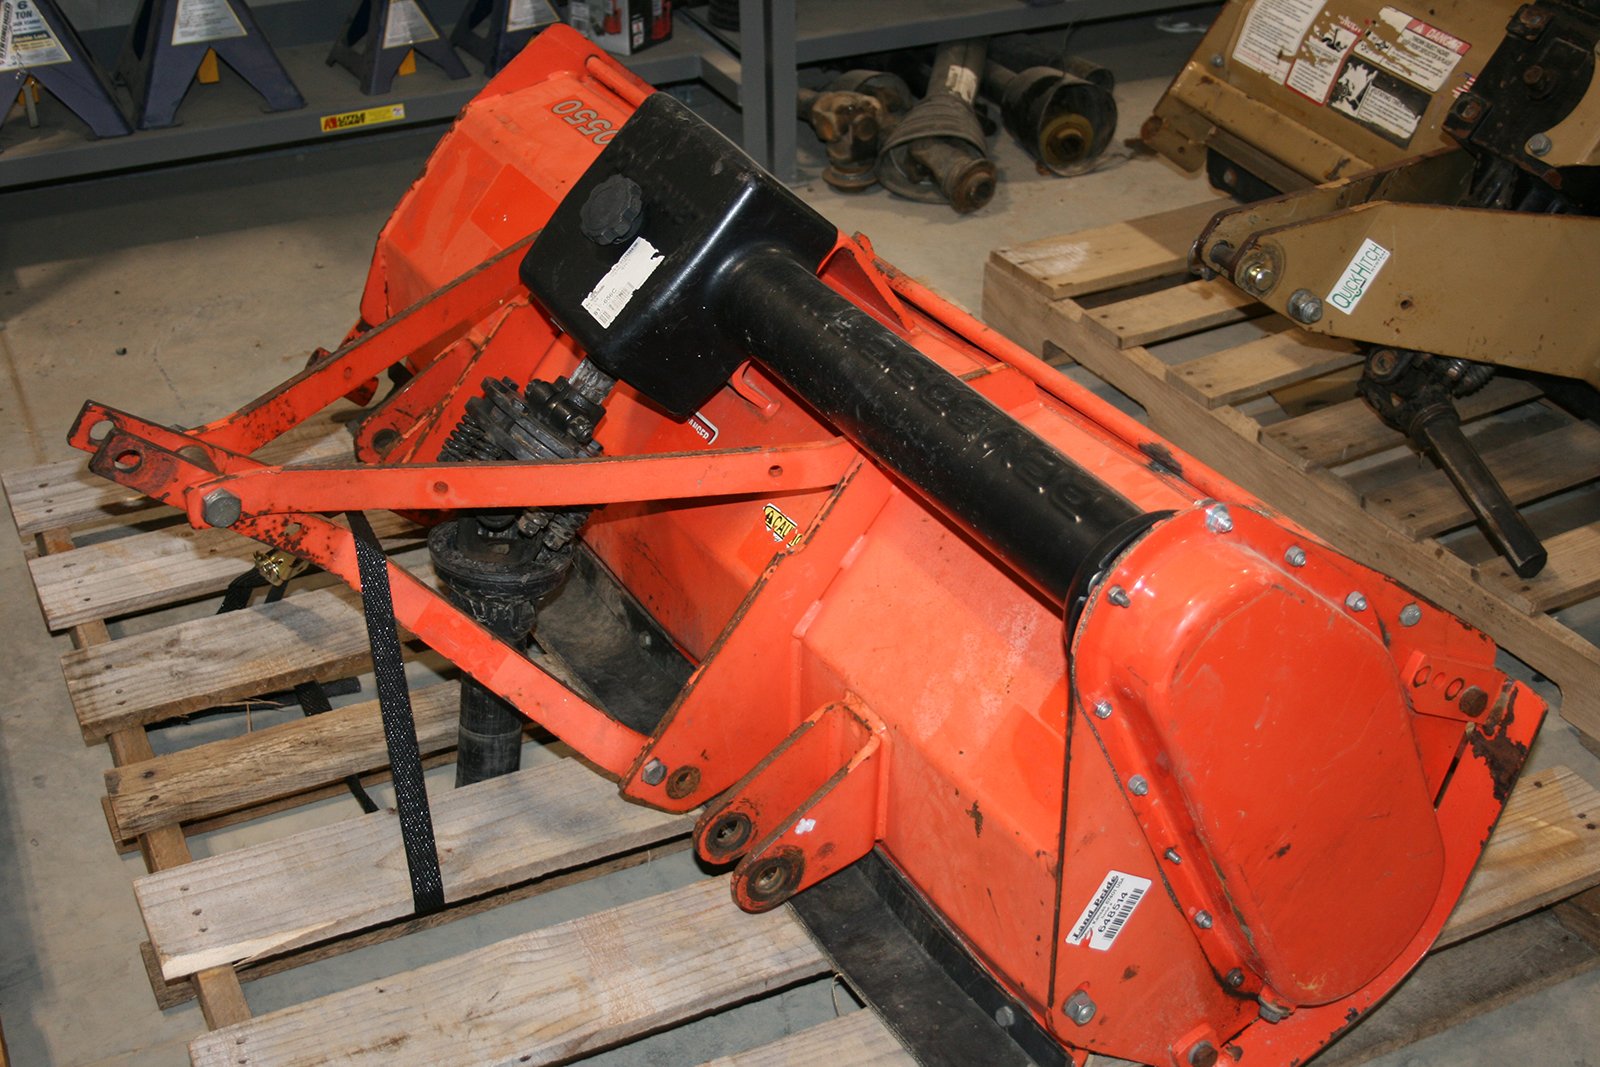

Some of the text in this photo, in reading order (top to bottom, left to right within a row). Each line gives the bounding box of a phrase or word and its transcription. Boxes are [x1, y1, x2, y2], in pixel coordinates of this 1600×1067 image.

[15, 10, 33, 19] TON
[17, 0, 28, 10] 6
[1072, 909, 1094, 941] Land
[1093, 874, 1120, 908] Pride
[1098, 892, 1128, 933] 648514
